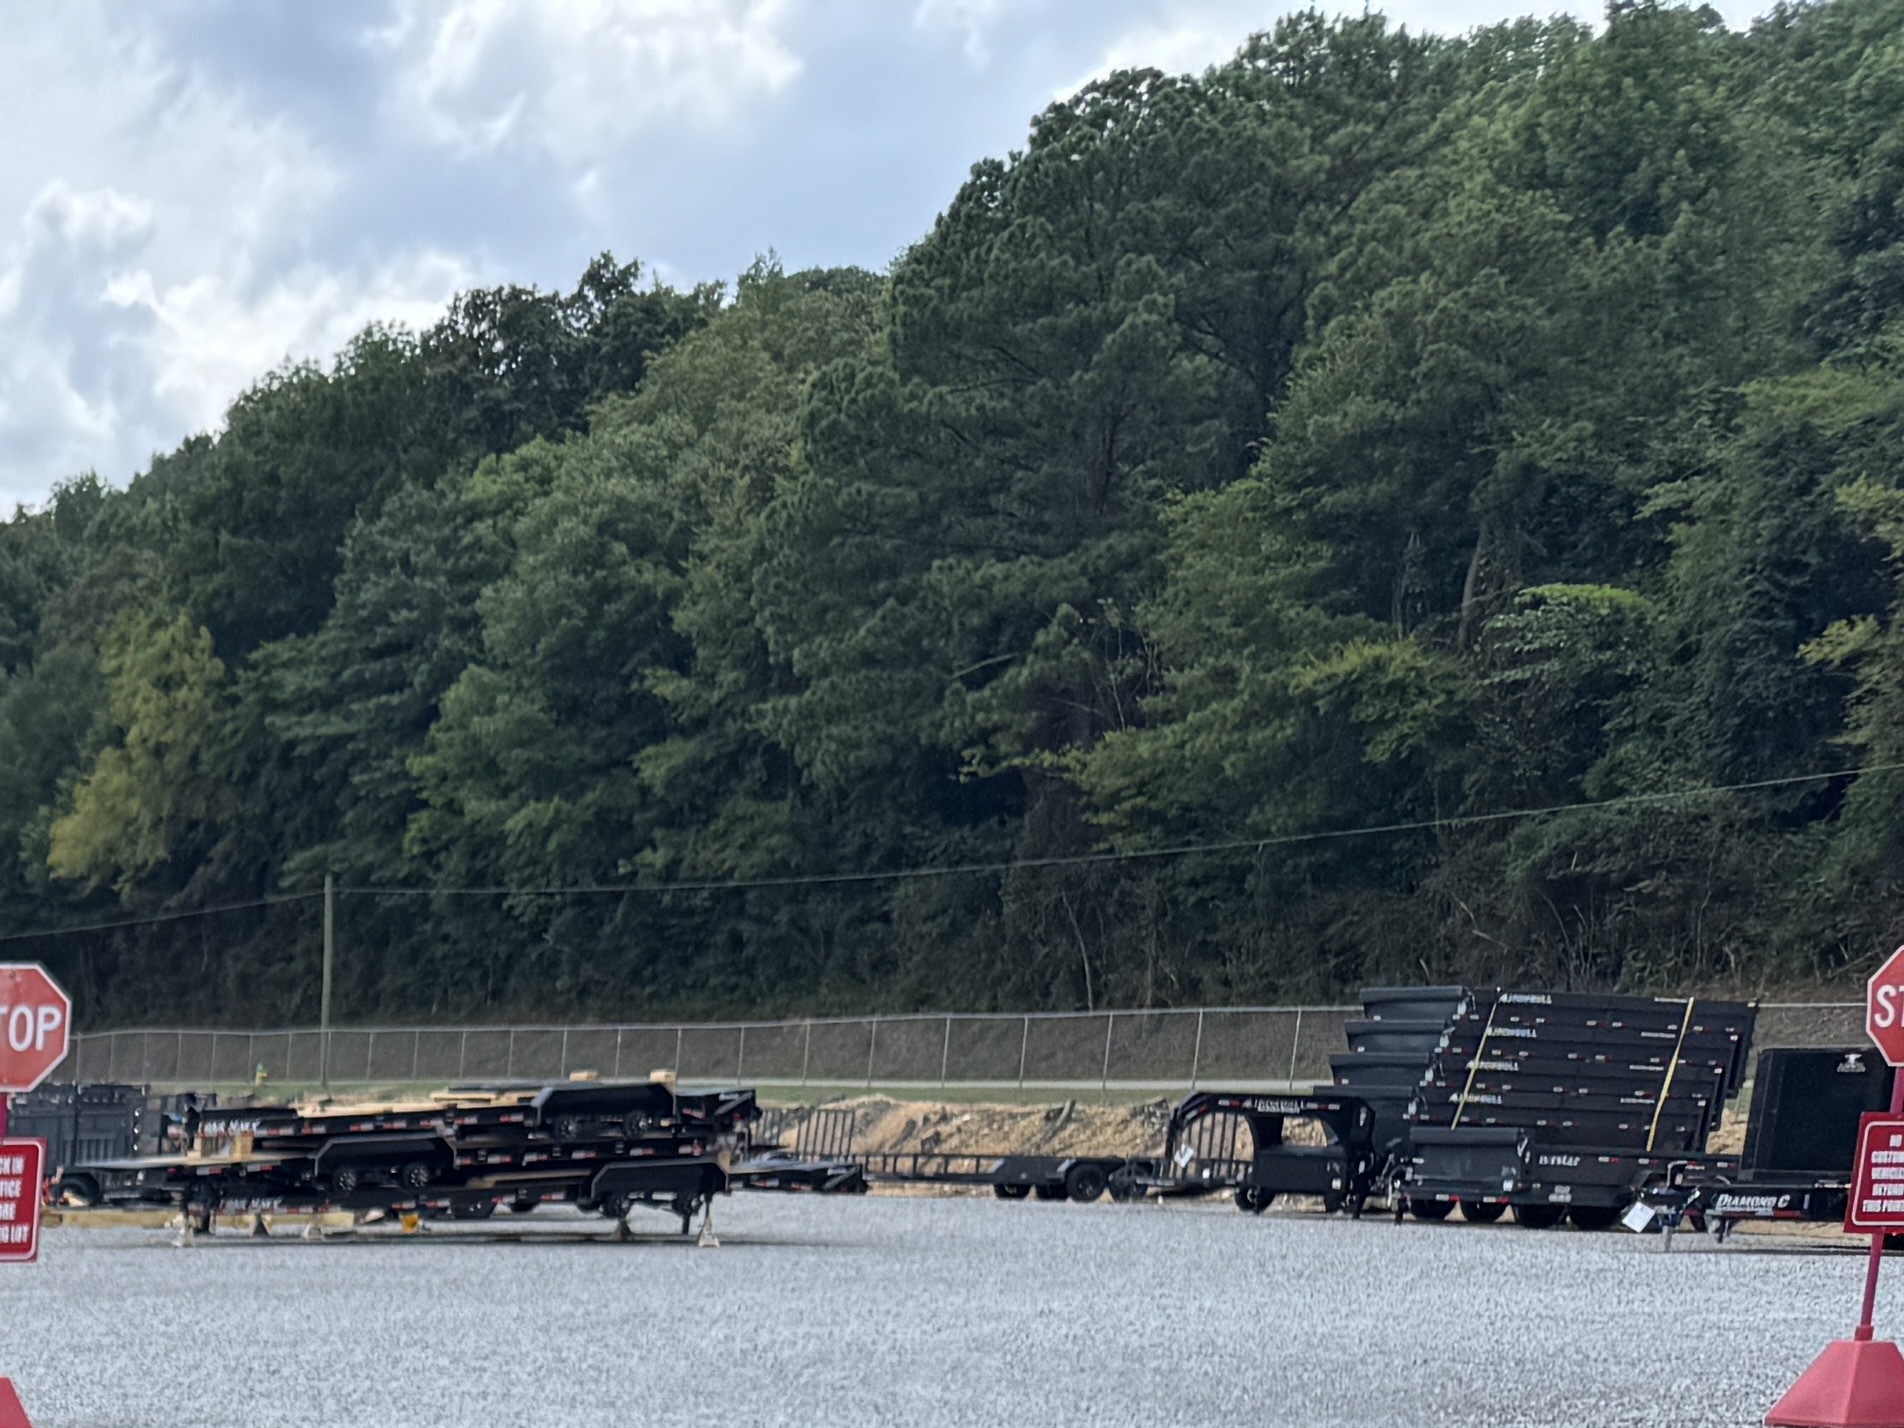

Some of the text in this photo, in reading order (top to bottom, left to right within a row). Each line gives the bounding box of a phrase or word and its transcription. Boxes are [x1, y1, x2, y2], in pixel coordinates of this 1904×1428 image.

[11, 1155, 24, 1174] IN
[1777, 1194, 1791, 1208] C
[11, 1225, 30, 1243] LOT
